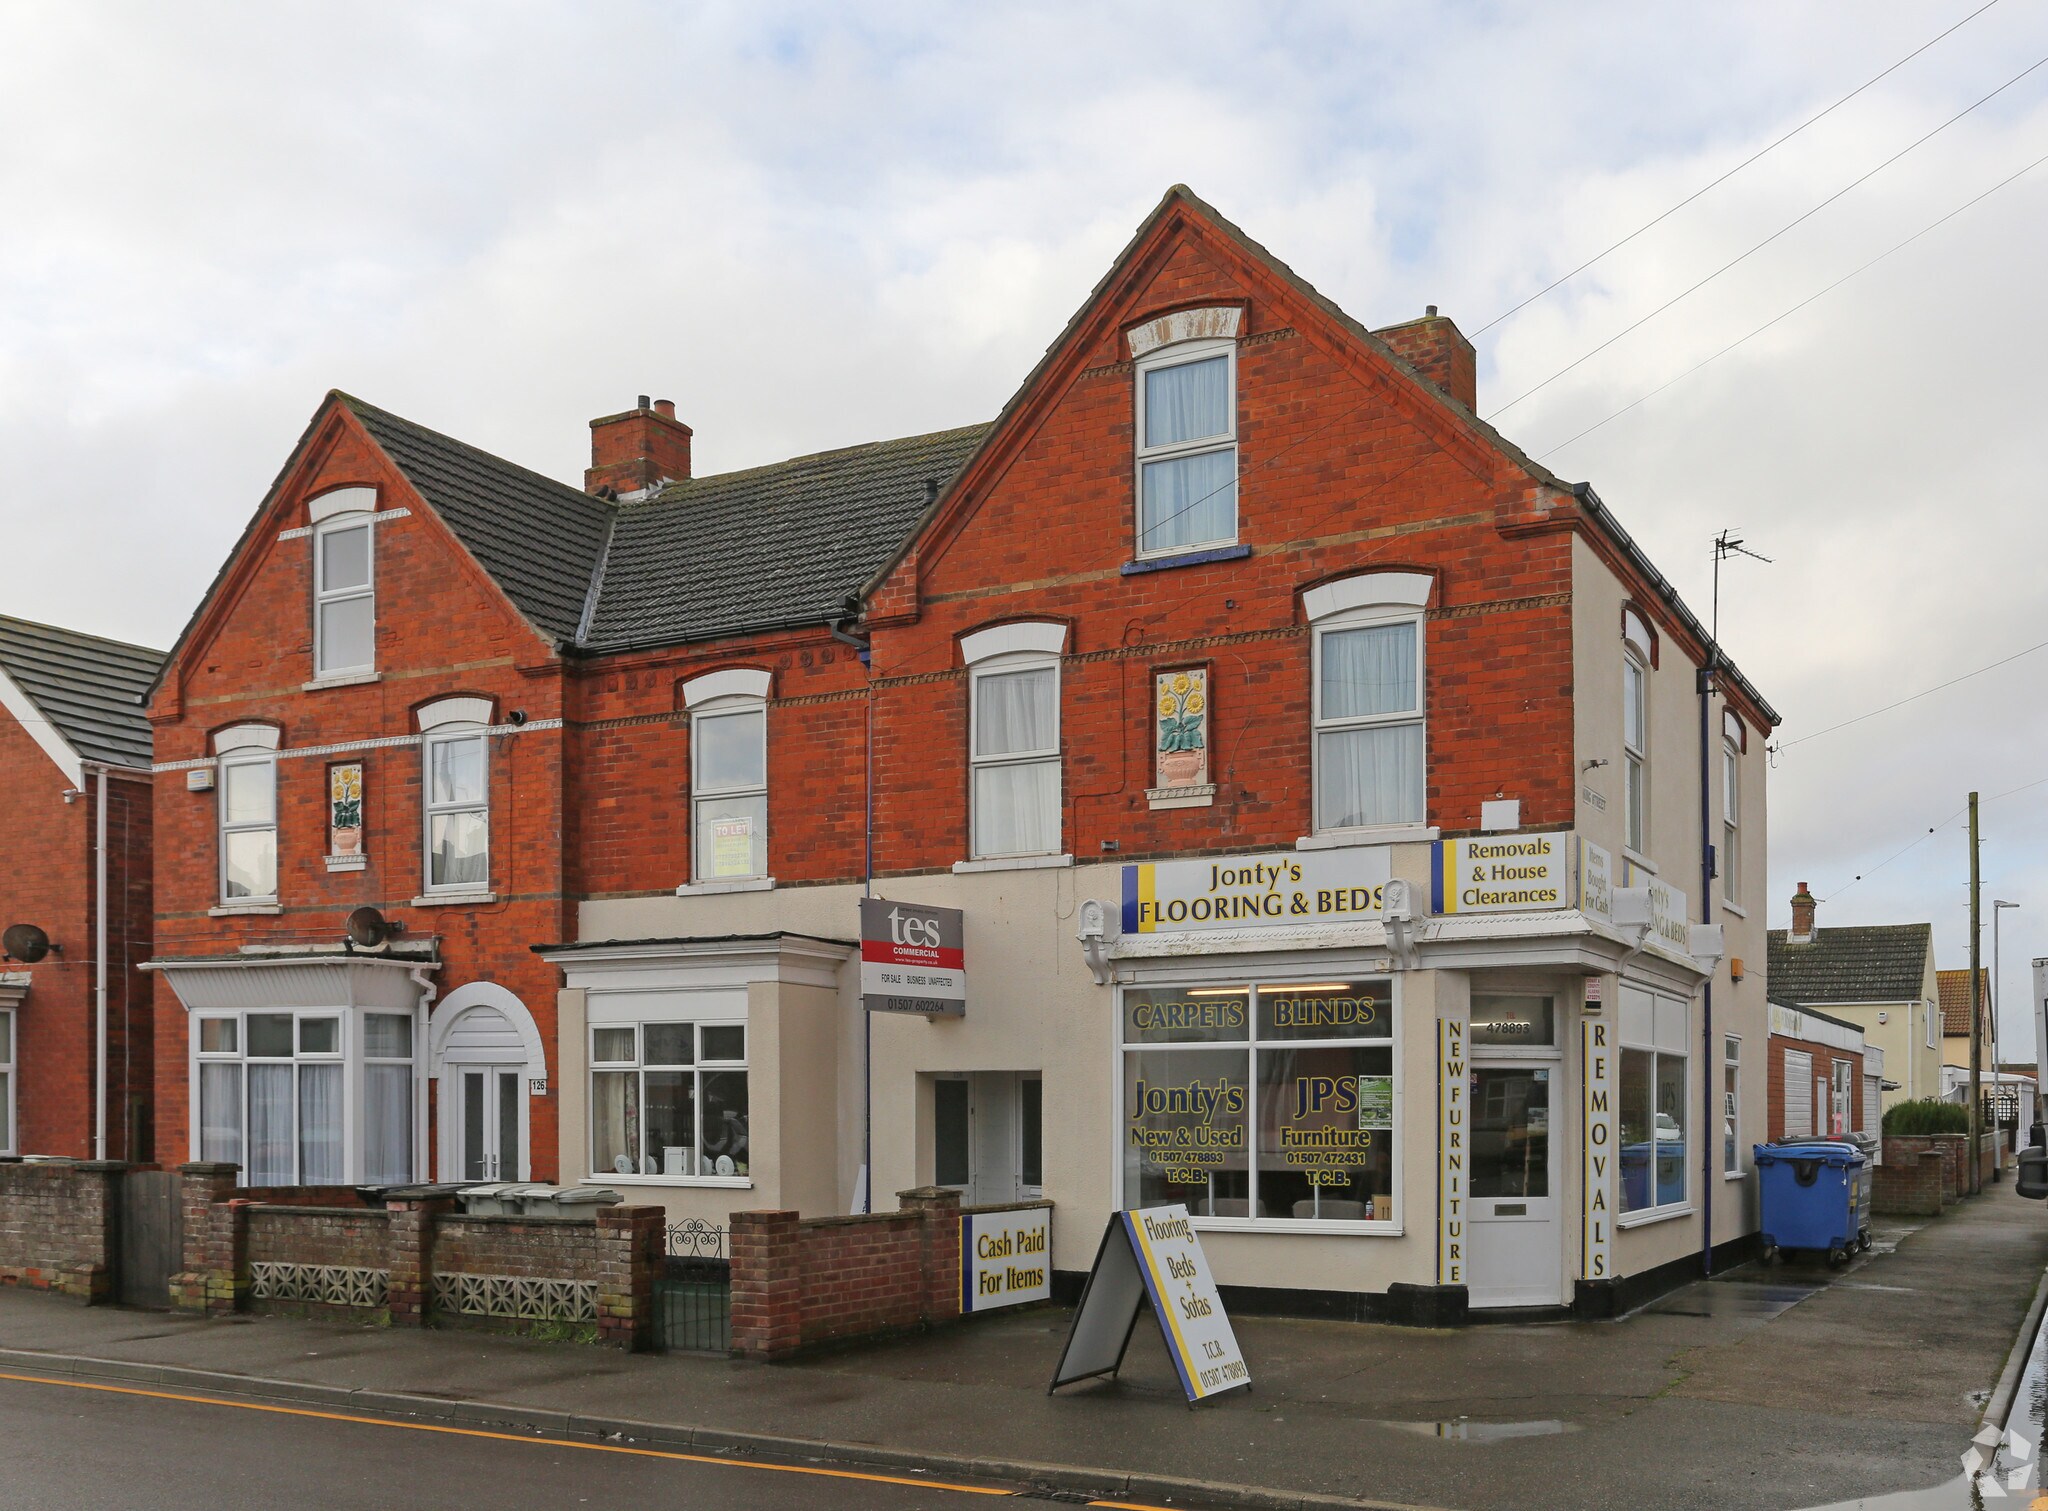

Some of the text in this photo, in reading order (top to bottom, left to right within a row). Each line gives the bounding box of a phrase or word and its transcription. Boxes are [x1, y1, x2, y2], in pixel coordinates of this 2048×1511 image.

[731, 824, 747, 835] LET
[1468, 838, 1550, 859] Removals
[1210, 859, 1301, 892] Jonty's
[1472, 864, 1547, 882] & House
[1588, 869, 1606, 894] Bought
[1139, 886, 1383, 923] FLOORING & BEDS
[1462, 887, 1557, 906] Clearances
[1586, 891, 1608, 914] For Cash
[888, 906, 940, 948] tes
[1671, 921, 1685, 945] BEDS
[893, 947, 939, 958] COMMERCIAL
[881, 974, 953, 987] FOR SALE BUSINESS UNAFFECTED
[888, 998, 944, 1012] 01507 602264
[1132, 1001, 1243, 1029] CARPETS
[1275, 997, 1375, 1026] BLINDS
[1487, 1023, 1530, 1034] 478893
[533, 1081, 545, 1090] 126
[1133, 1078, 1244, 1124] Jonty's
[1293, 1076, 1357, 1119] JPS
[1131, 1125, 1242, 1147] New & Used
[1280, 1125, 1371, 1147] Furniture
[1150, 1151, 1224, 1164] 01507 478893
[1287, 1152, 1365, 1165] 01507 472431
[1447, 1021, 1464, 1282] NEW FURNITURE
[1591, 1024, 1608, 1277] REMOVALS
[1166, 1168, 1207, 1184] T.C.B.
[1306, 1170, 1350, 1186] T.C.B.
[1144, 1214, 1194, 1243] Flooring
[977, 1226, 1045, 1259] Cash Paid
[1166, 1252, 1196, 1280] Beds
[979, 1267, 1043, 1295] For Items
[1180, 1292, 1212, 1320] Sofas
[1202, 1340, 1225, 1360] T.C.B.
[1200, 1360, 1248, 1389] 01507 478893
